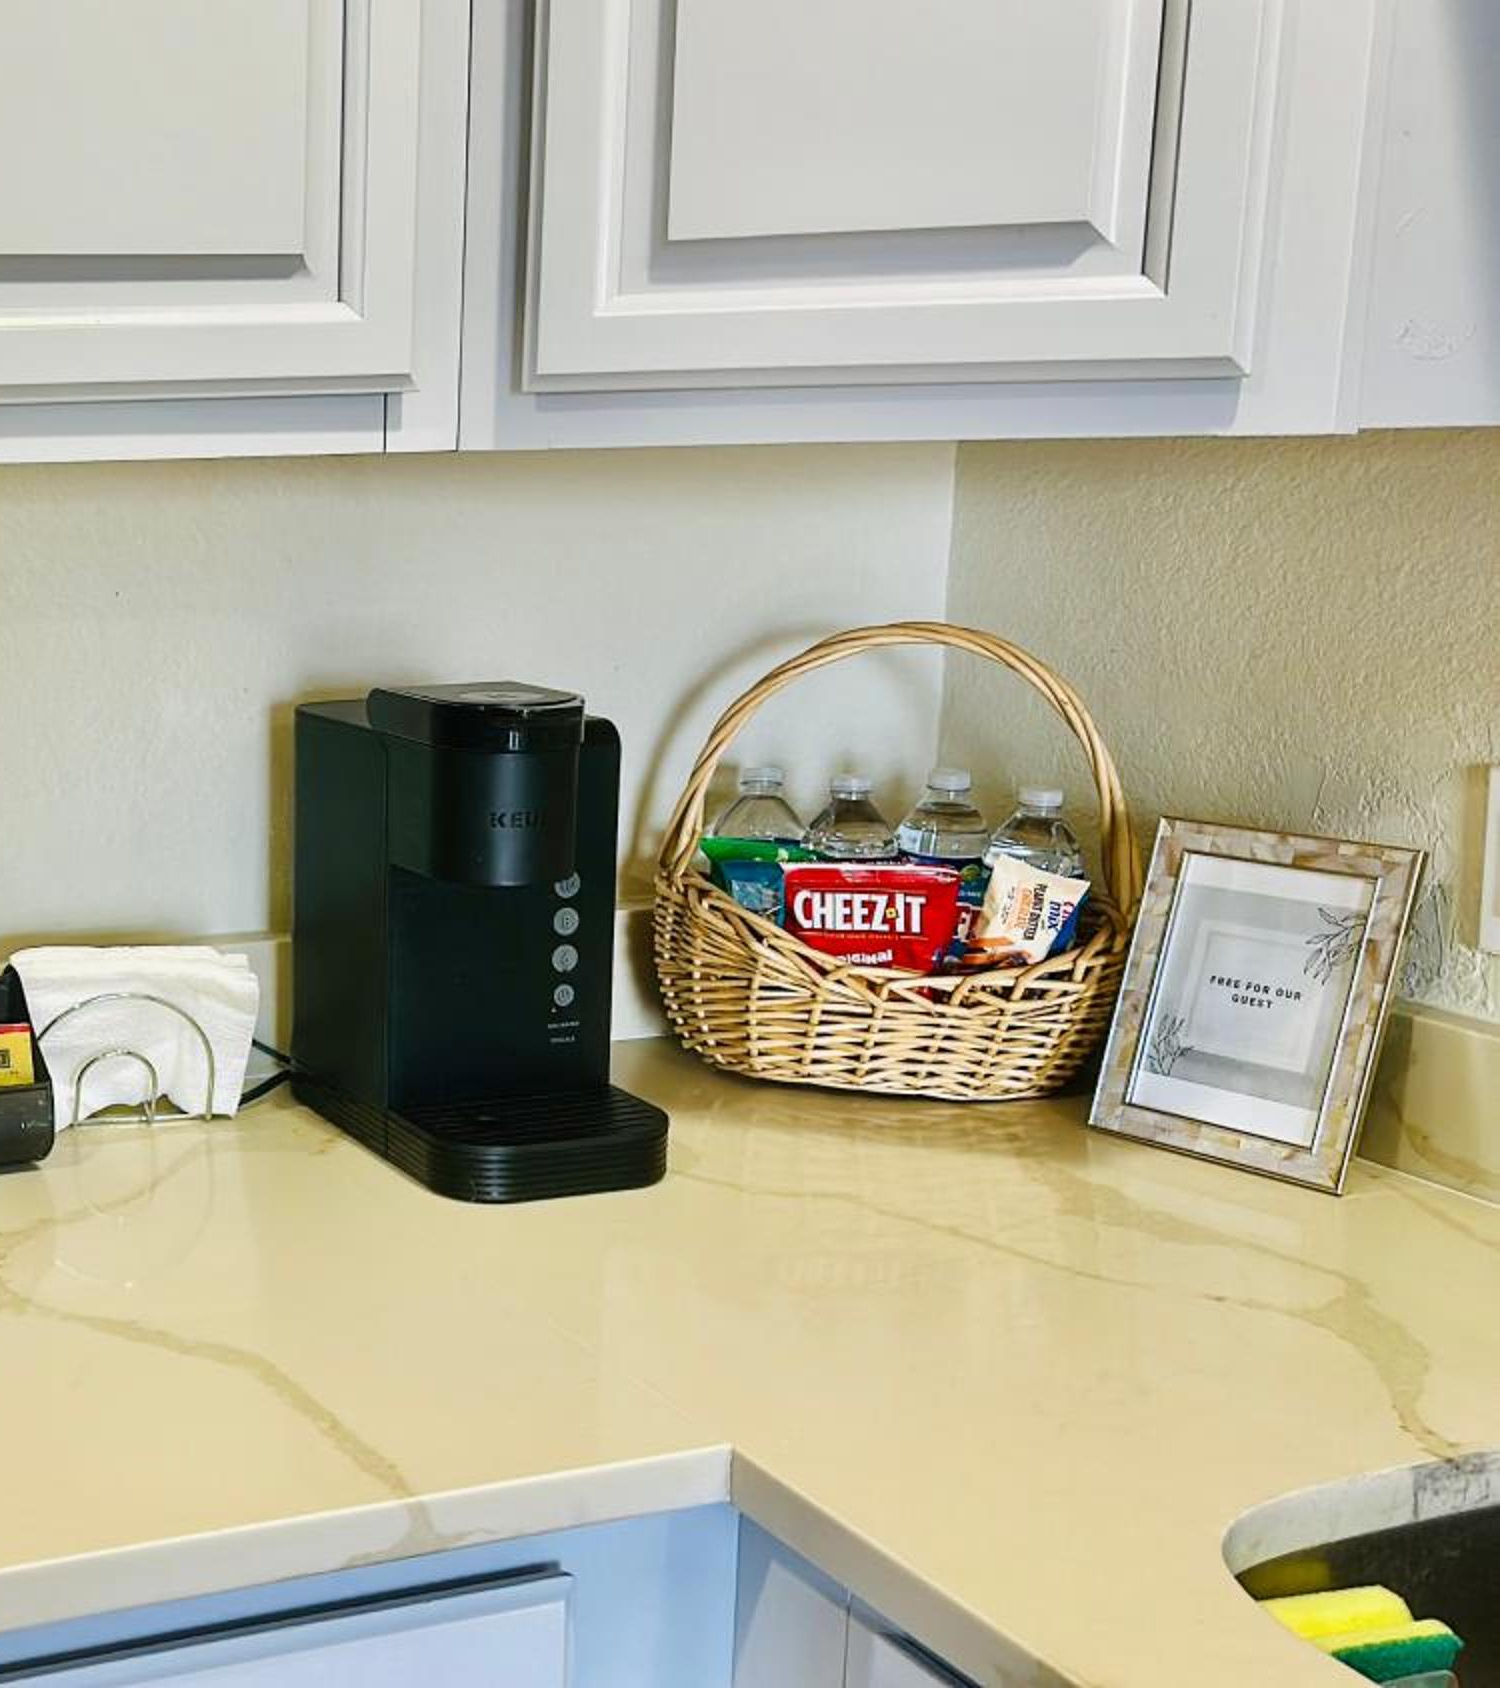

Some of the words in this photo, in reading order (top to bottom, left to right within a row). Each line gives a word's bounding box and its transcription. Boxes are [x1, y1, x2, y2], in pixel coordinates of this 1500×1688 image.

[1209, 975, 1240, 990] FREE
[1245, 982, 1270, 995] FOR
[1275, 987, 1302, 1001] OUR
[1231, 993, 1272, 1009] GUEST
